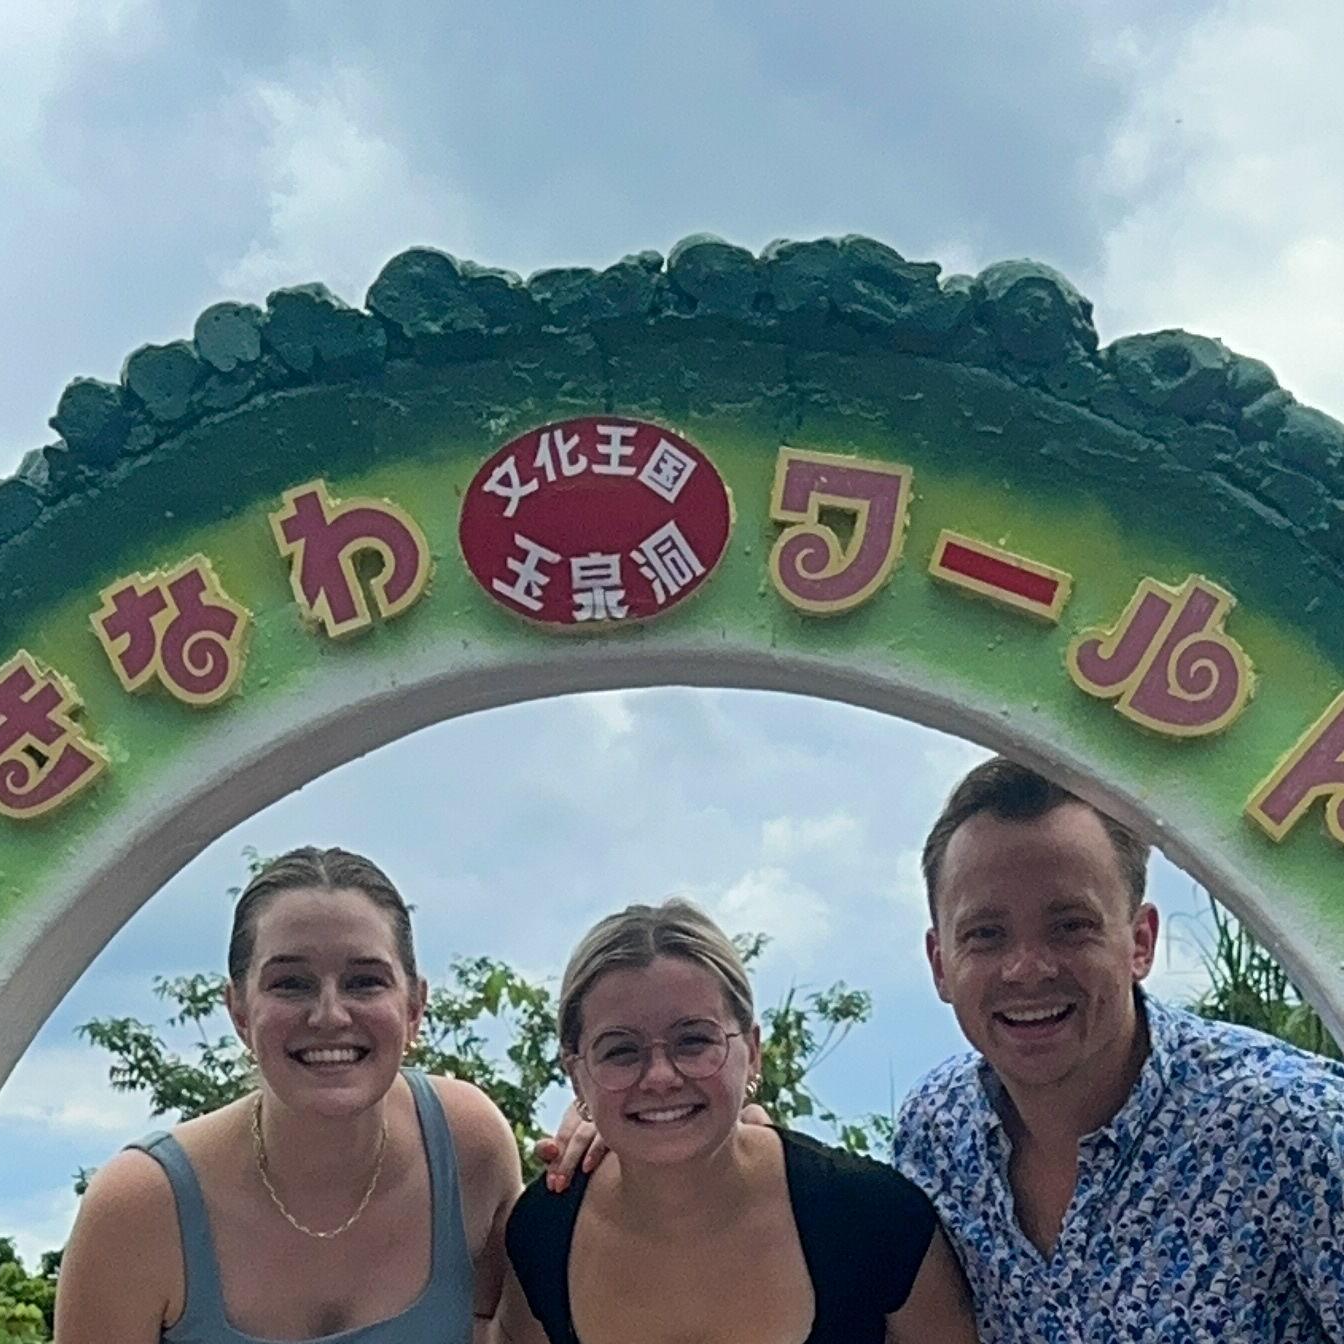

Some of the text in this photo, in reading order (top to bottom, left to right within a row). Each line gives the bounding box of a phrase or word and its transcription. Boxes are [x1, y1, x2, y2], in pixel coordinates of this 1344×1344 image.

[482, 424, 698, 518] 文化王国
[491, 519, 707, 622] 玉泉洞
